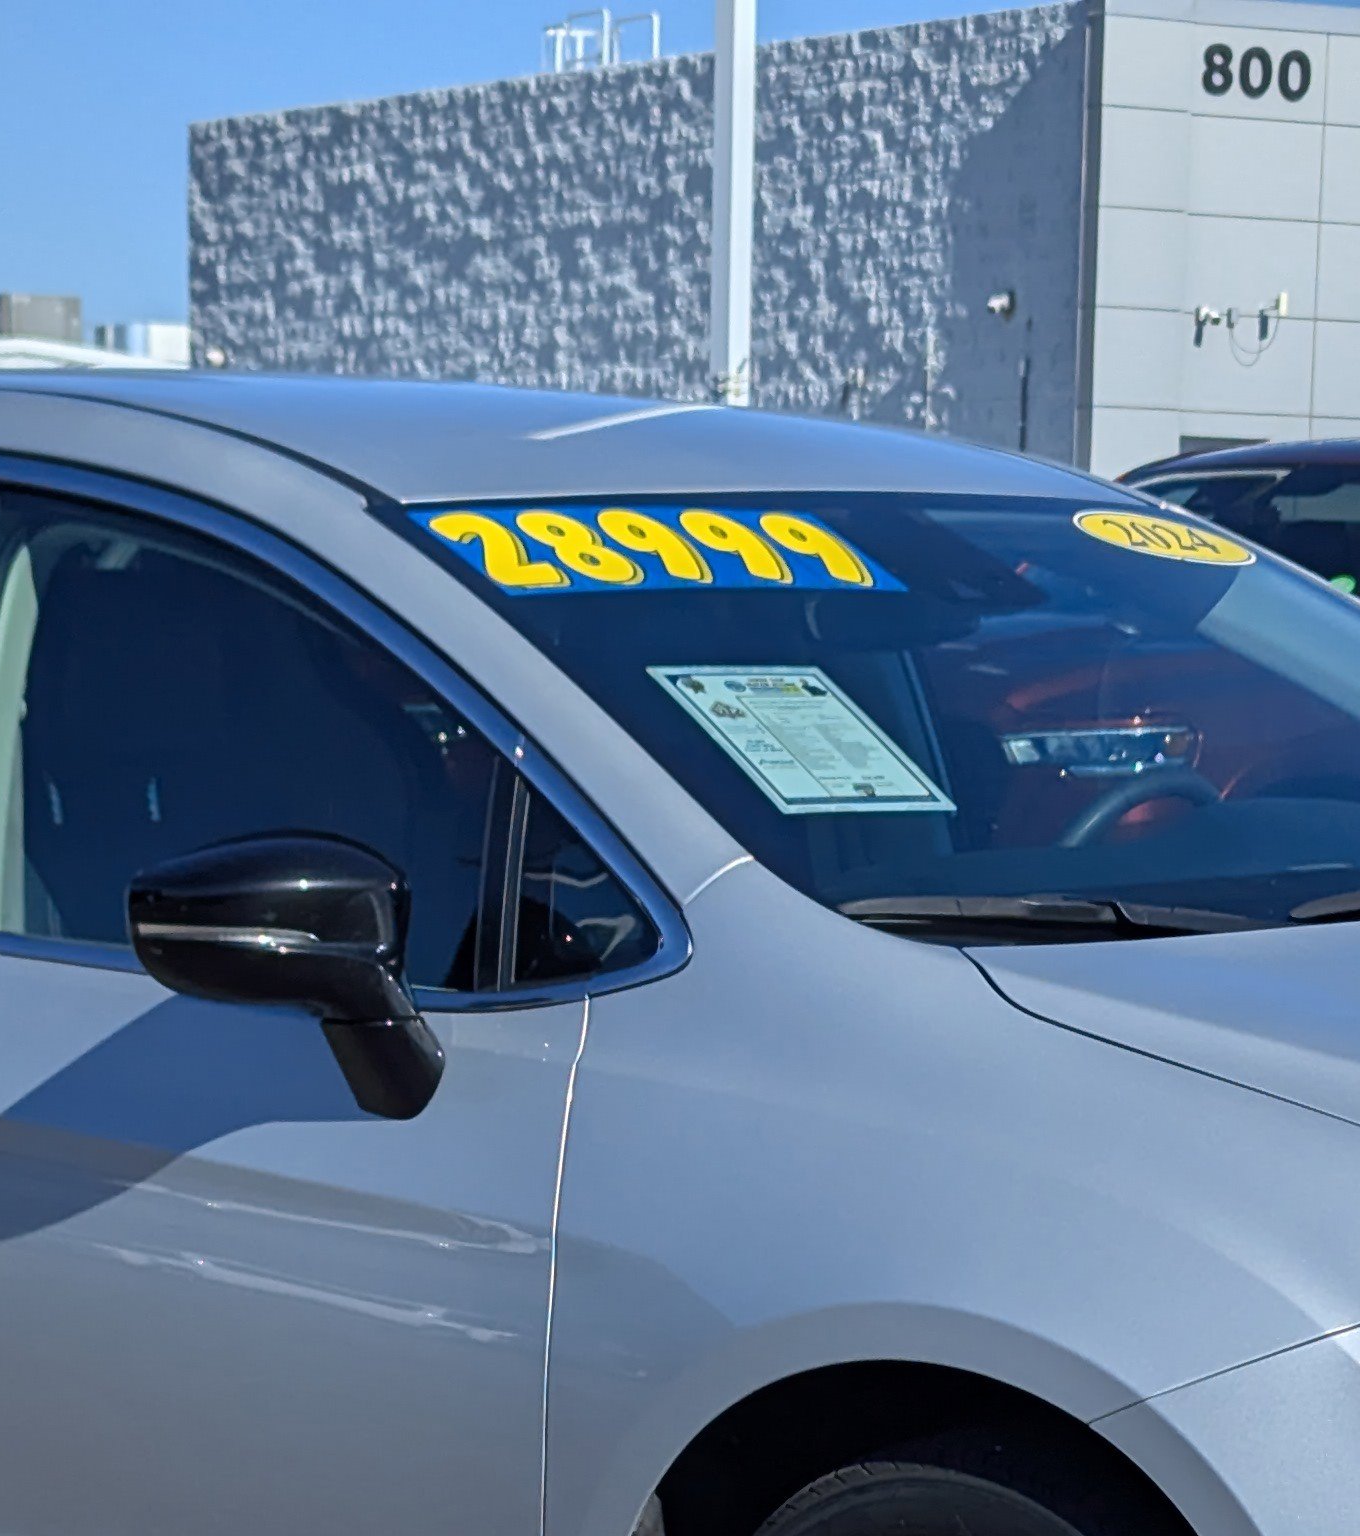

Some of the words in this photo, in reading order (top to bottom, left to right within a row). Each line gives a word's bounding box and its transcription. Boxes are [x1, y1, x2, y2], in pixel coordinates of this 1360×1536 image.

[1202, 42, 1312, 103] 800
[429, 509, 874, 587] 28999
[1102, 519, 1222, 554] 2024
